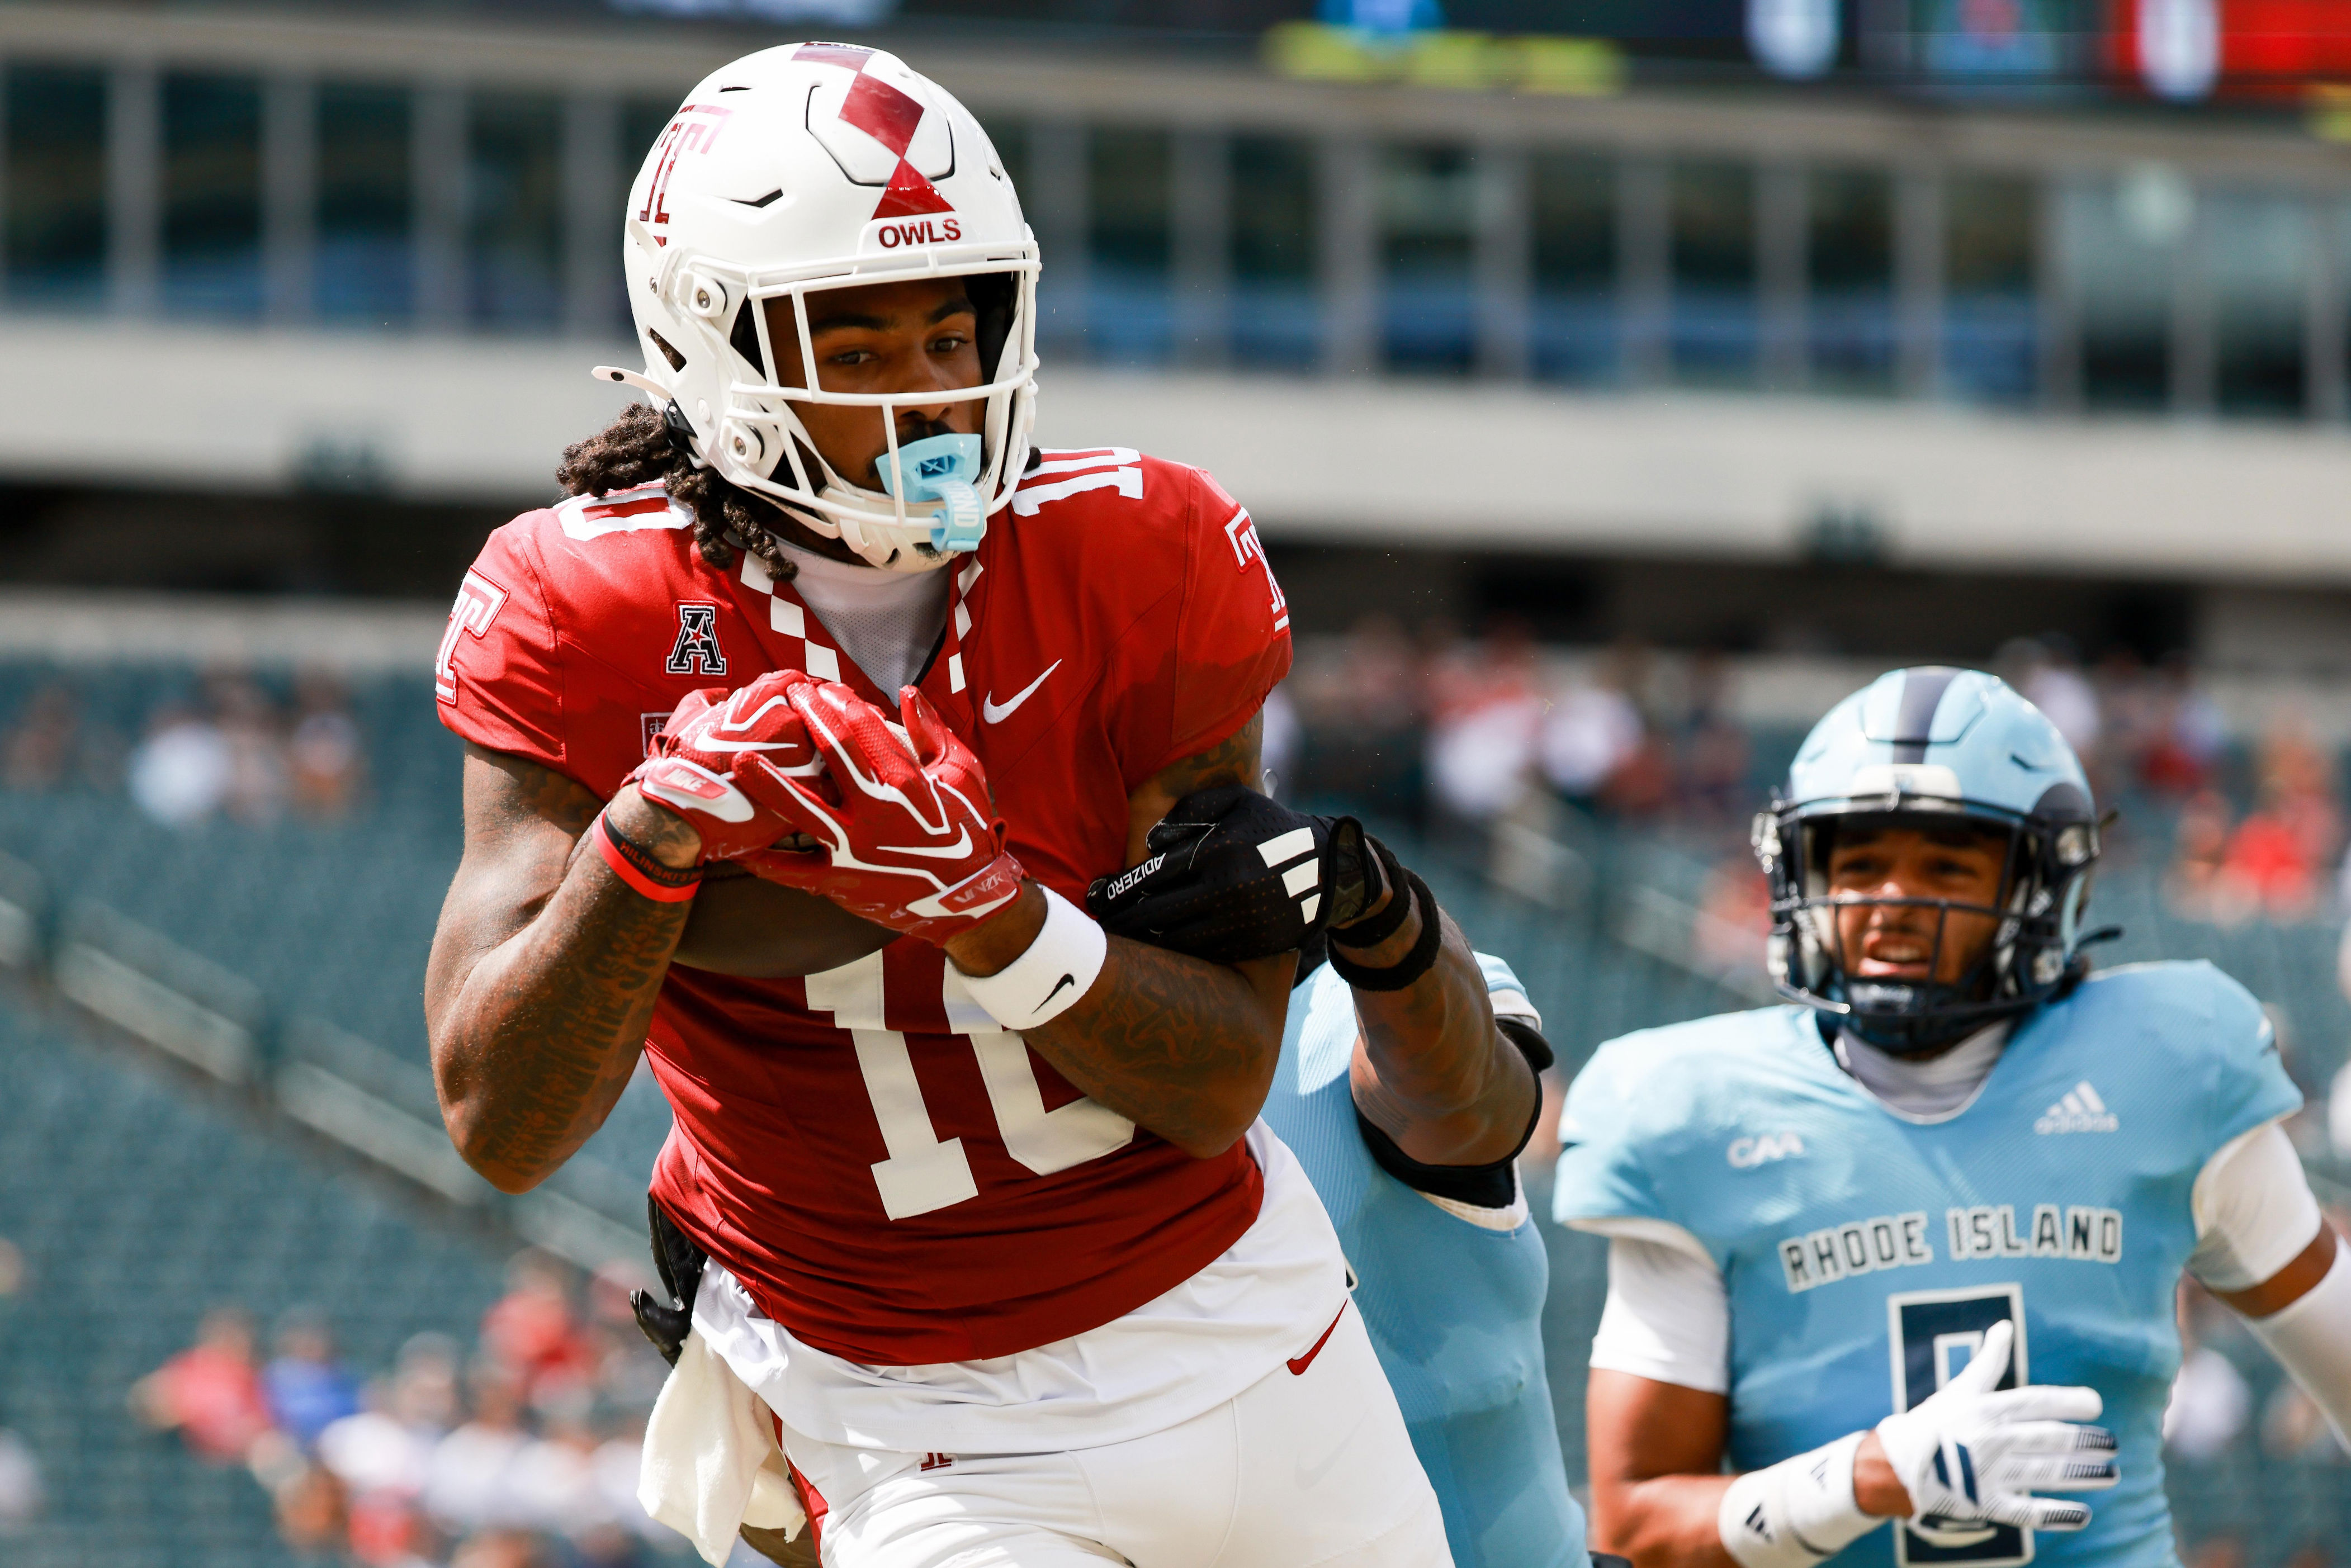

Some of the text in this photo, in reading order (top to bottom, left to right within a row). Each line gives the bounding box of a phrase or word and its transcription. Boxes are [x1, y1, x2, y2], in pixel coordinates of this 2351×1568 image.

[878, 218, 961, 248] OWLS
[666, 604, 727, 675] A
[663, 768, 708, 792] NIKE
[1107, 852, 1167, 901] ADIZERO
[2034, 1112, 2120, 1135] adidas
[1778, 1204, 2122, 1294] RHODE ISLAND
